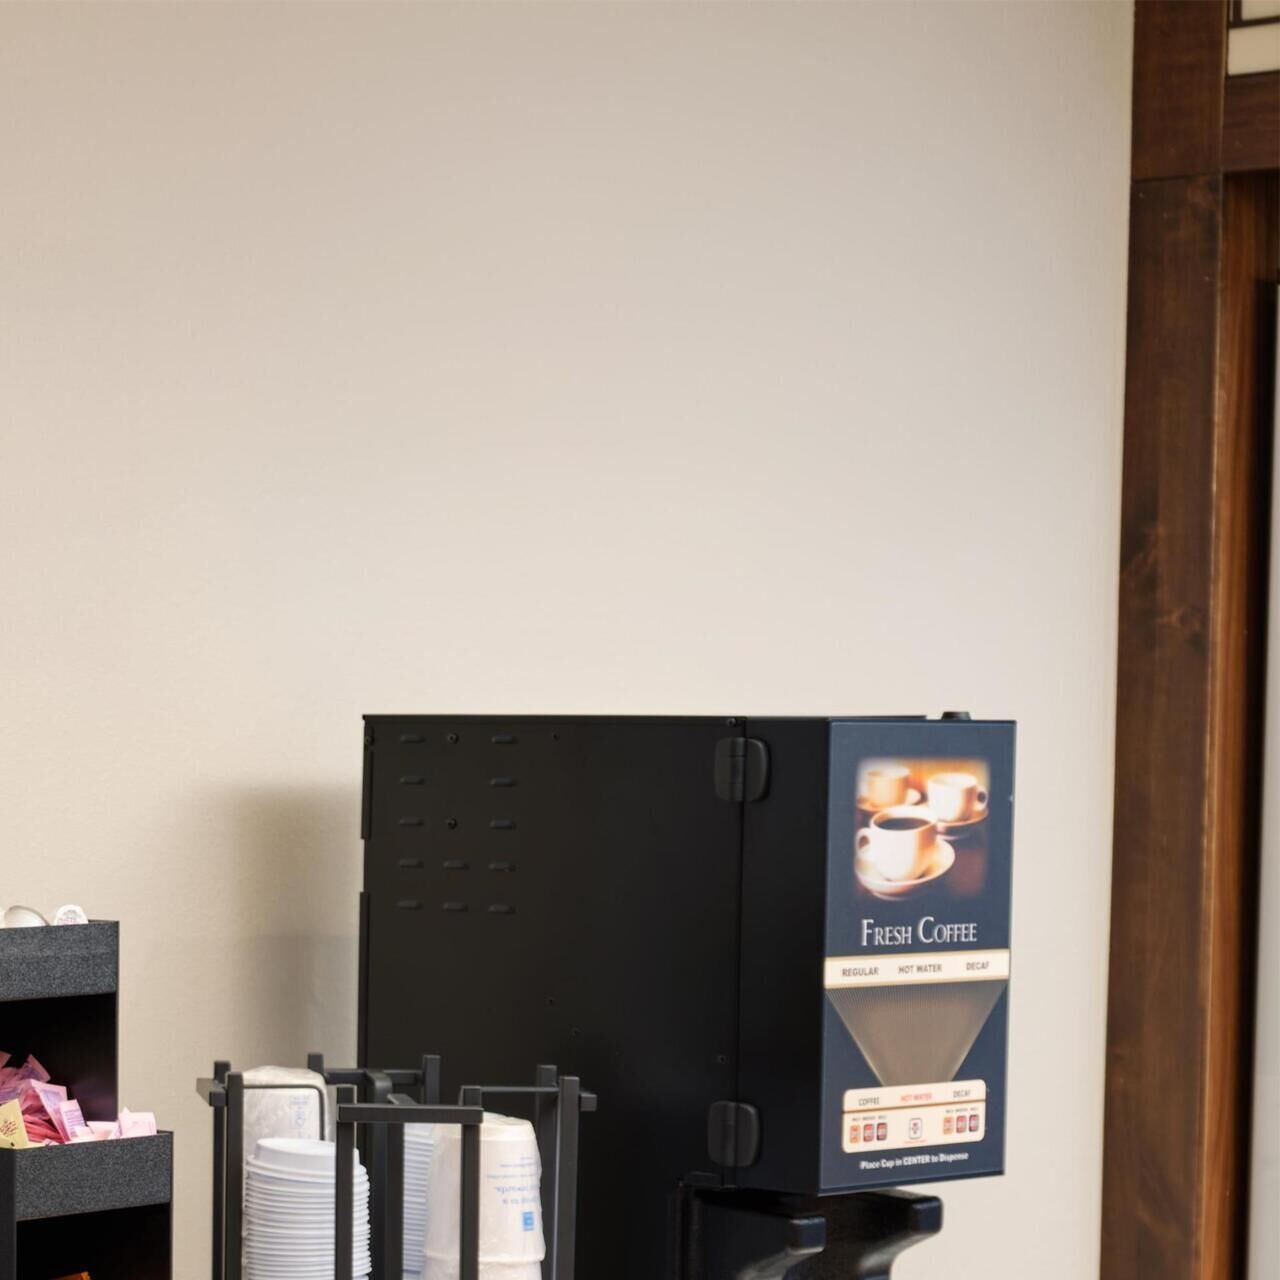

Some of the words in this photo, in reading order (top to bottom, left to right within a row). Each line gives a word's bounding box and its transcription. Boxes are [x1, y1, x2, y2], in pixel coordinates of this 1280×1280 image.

[861, 919, 912, 946] FRESH
[917, 916, 978, 943] COFFEE
[842, 967, 879, 977] REGULAR
[898, 965, 915, 974] HOT
[916, 963, 943, 974] WATER
[966, 961, 990, 972] DECAF
[903, 1155, 931, 1165] CENTER
